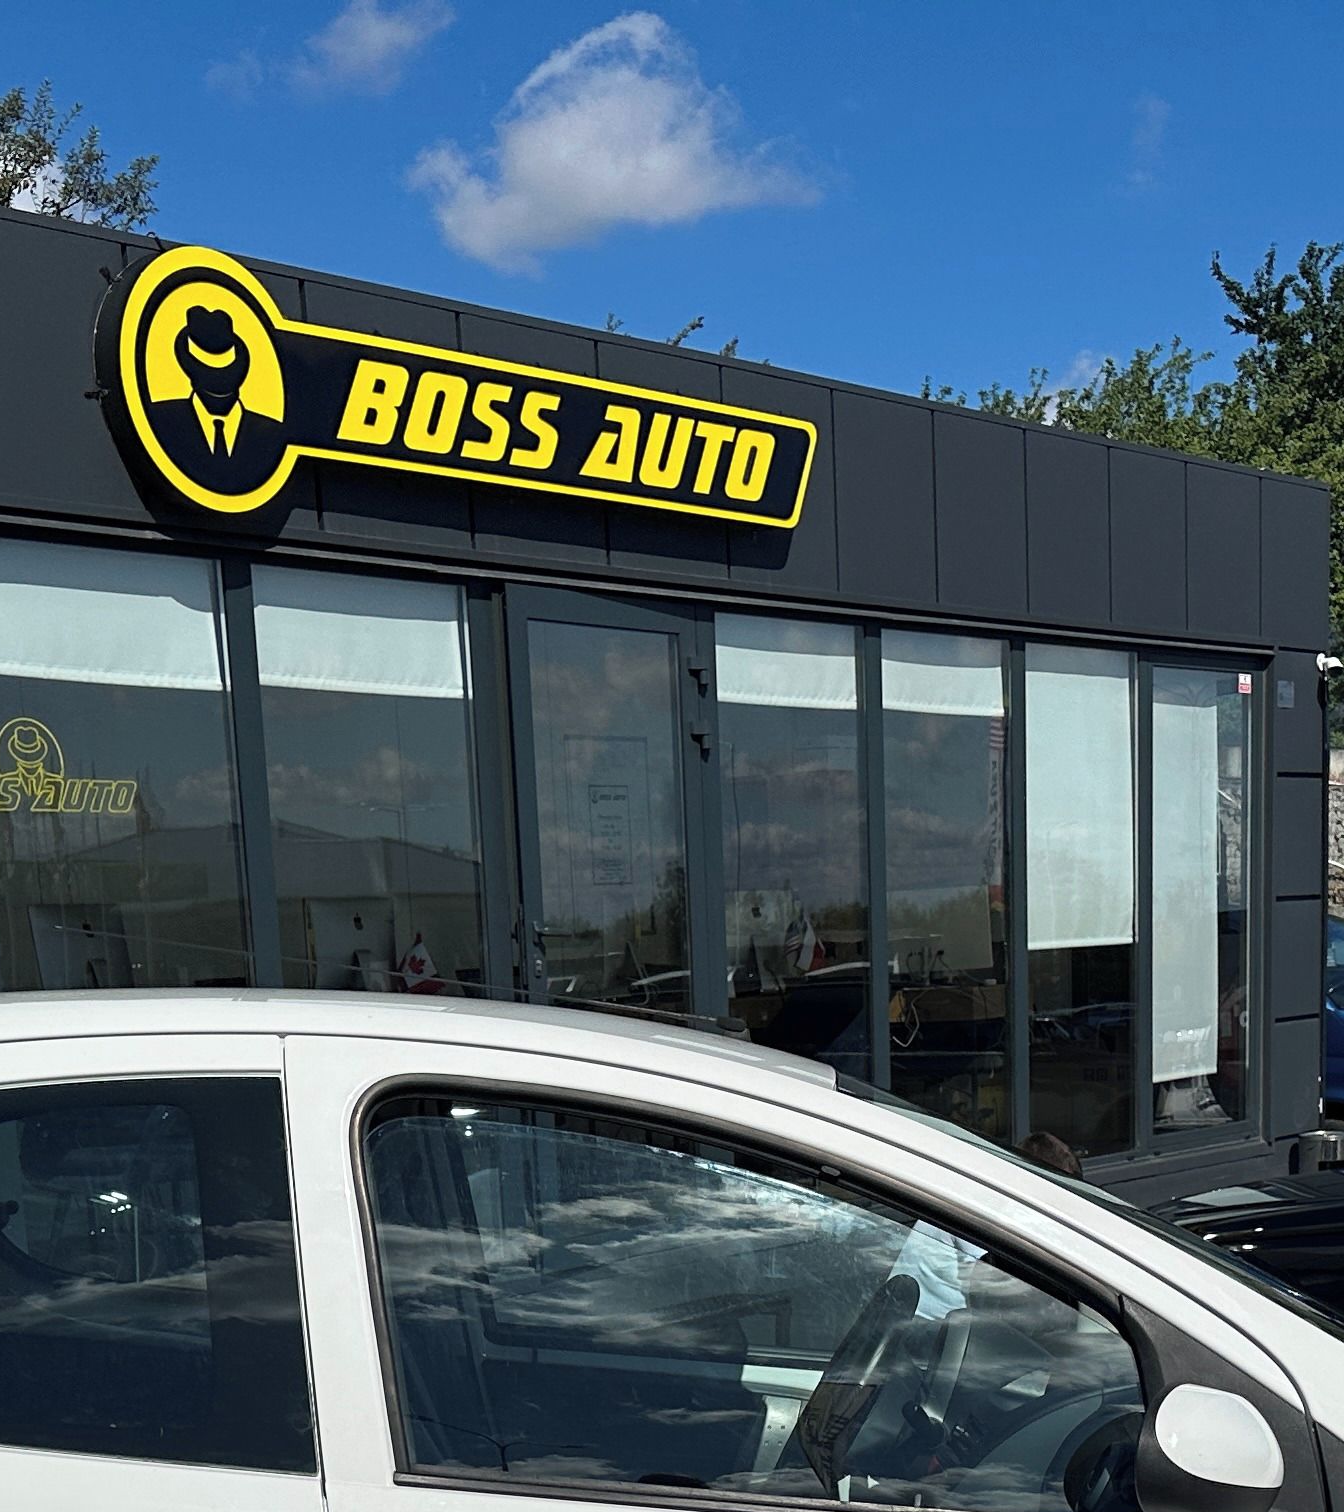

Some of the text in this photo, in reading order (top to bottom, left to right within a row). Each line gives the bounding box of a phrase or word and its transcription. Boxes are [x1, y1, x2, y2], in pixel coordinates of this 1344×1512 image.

[337, 359, 776, 502] BOSS AUTO
[30, 778, 137, 814] AUTO
